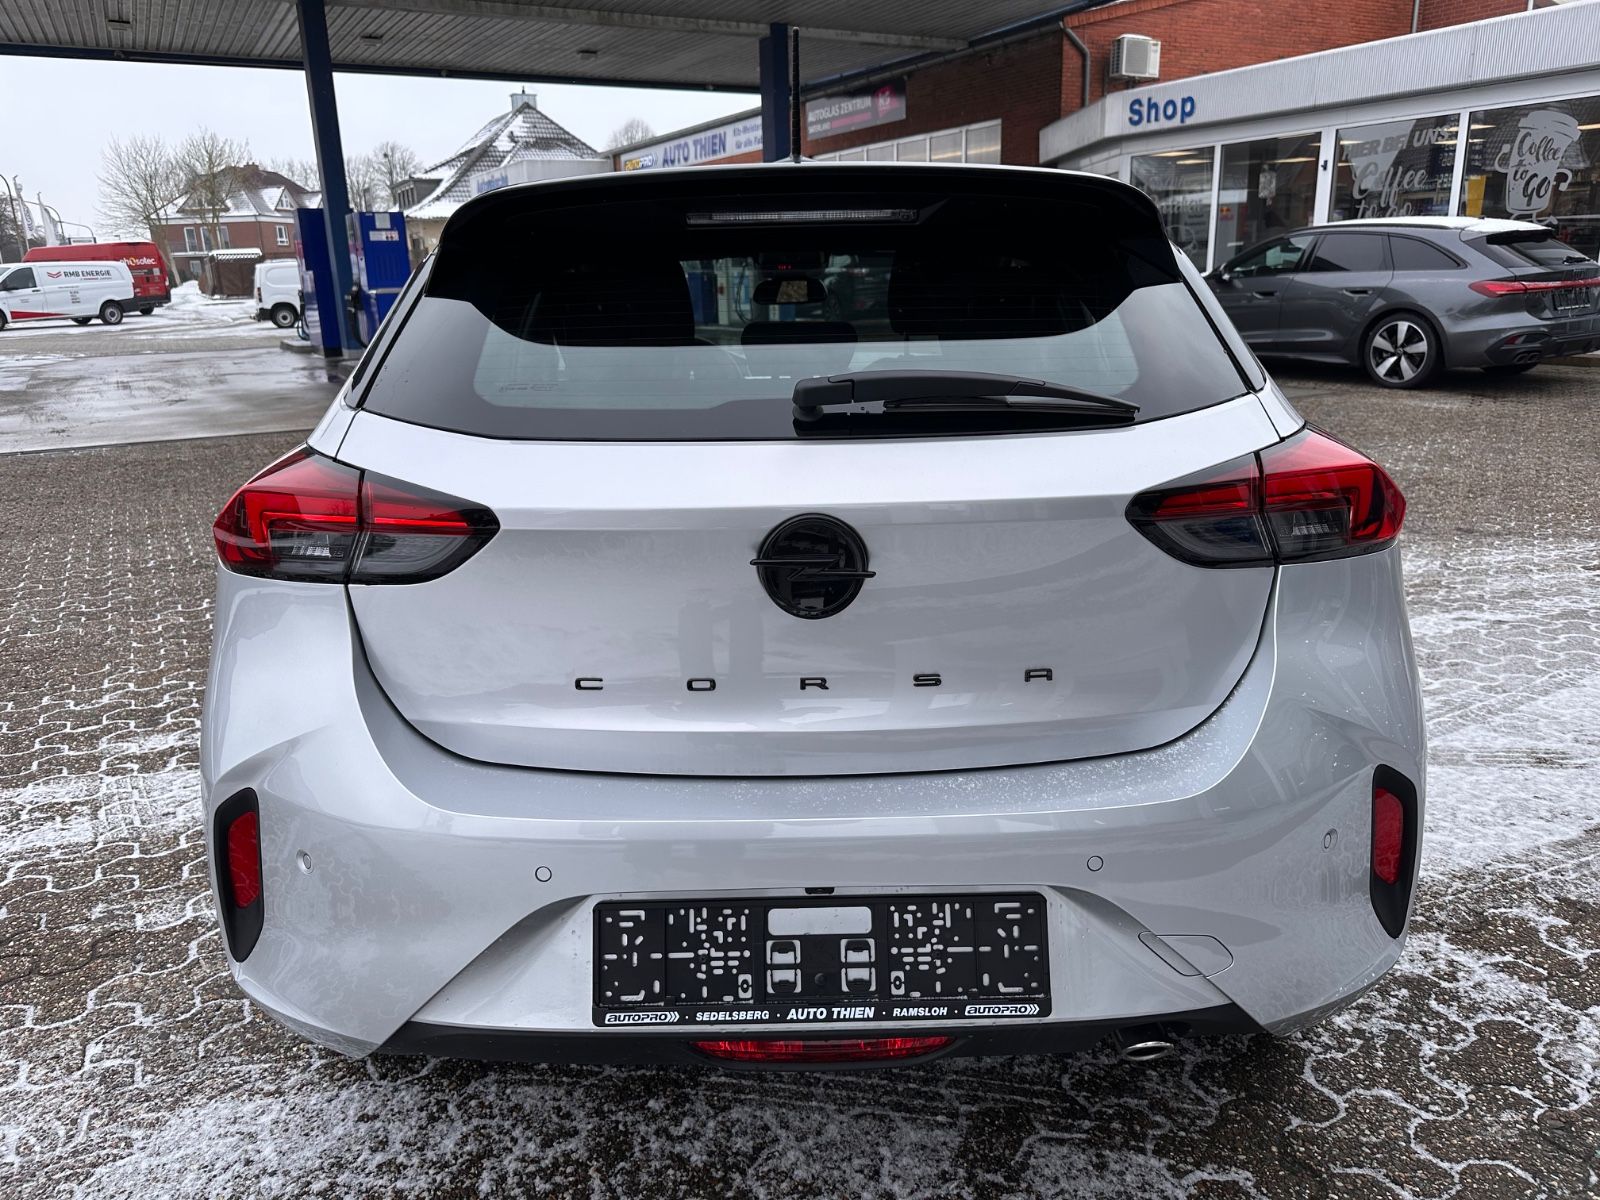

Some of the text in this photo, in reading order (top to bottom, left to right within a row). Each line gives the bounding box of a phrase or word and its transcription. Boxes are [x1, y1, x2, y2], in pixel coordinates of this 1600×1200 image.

[808, 96, 872, 123] AUTOGLAS ZENTRUM
[1128, 96, 1195, 126] Shop
[662, 141, 689, 168] AUTO
[692, 131, 727, 160] THIEN
[1412, 125, 1450, 148] UNS
[1518, 131, 1561, 163] Coffee
[1352, 162, 1427, 208] Coffee
[63, 269, 112, 278] RMB ENERGIE
[575, 668, 1053, 692] CORSA
[695, 1010, 770, 1022] SEDELSBERG
[786, 1008, 827, 1021] AUTO
[832, 1007, 875, 1019] THIEN
[892, 1006, 948, 1017] RAMSLOH
